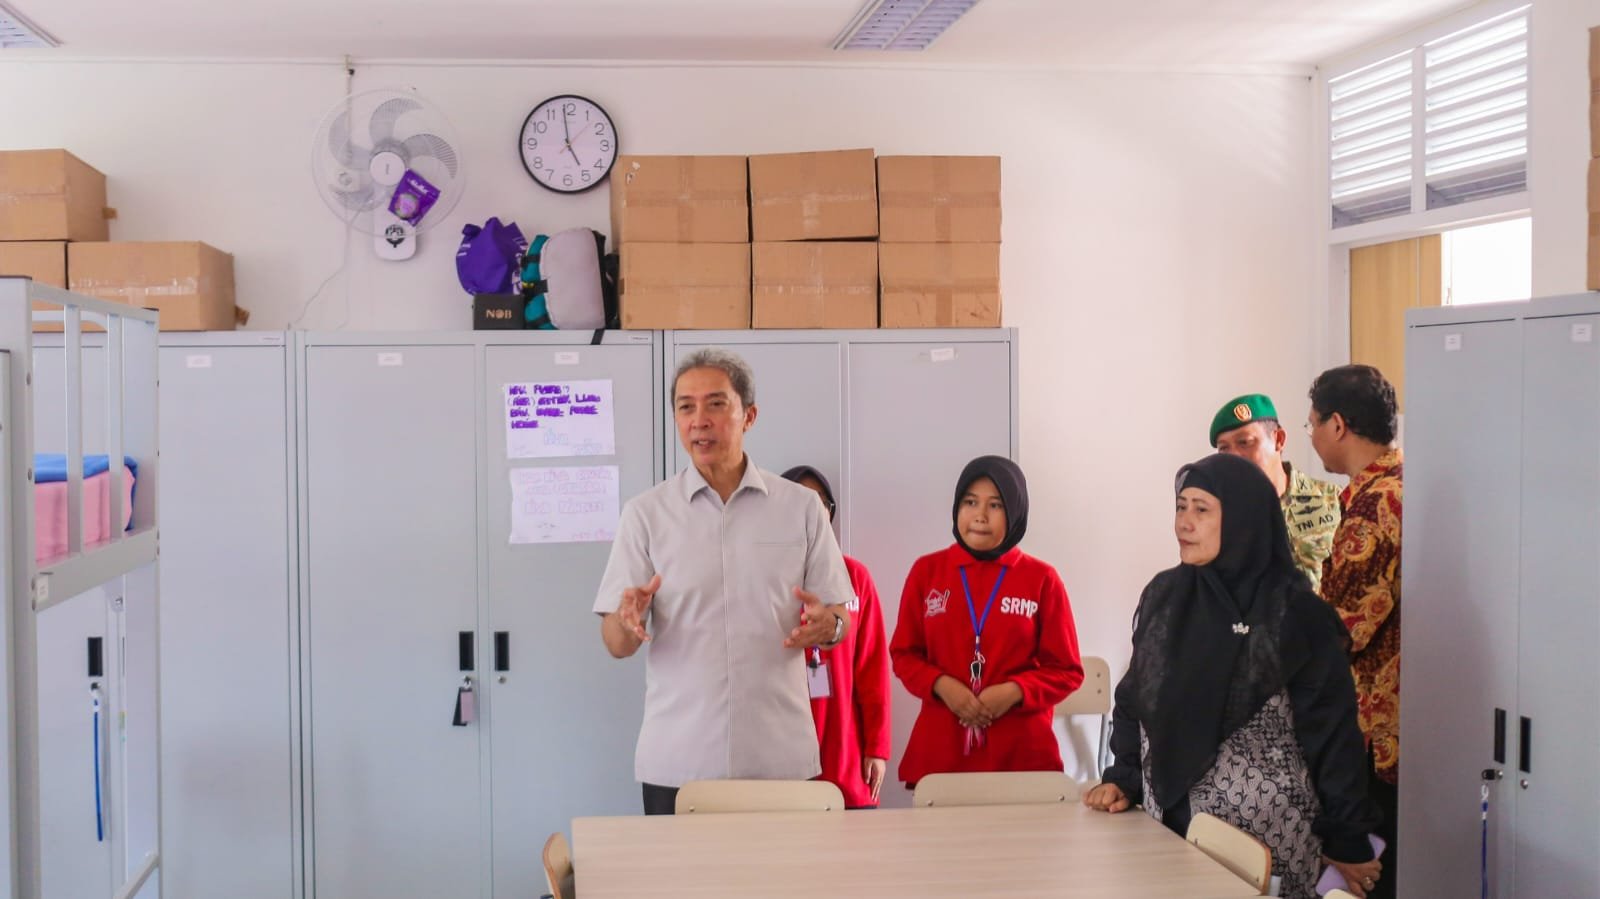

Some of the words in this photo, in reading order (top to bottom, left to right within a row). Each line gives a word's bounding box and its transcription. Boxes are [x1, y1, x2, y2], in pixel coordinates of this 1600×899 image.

[546, 109, 556, 120] 11
[533, 121, 548, 134] 10
[594, 122, 604, 136] 2
[528, 138, 538, 150] 9
[599, 139, 610, 152] 3
[533, 156, 543, 169] 8
[593, 158, 606, 171] 4
[545, 168, 555, 181] 7
[562, 174, 573, 187] 6
[581, 169, 591, 182] 5
[1296, 520, 1314, 532] TNI
[1319, 514, 1334, 524] AD
[1000, 596, 1038, 618] SRMP
